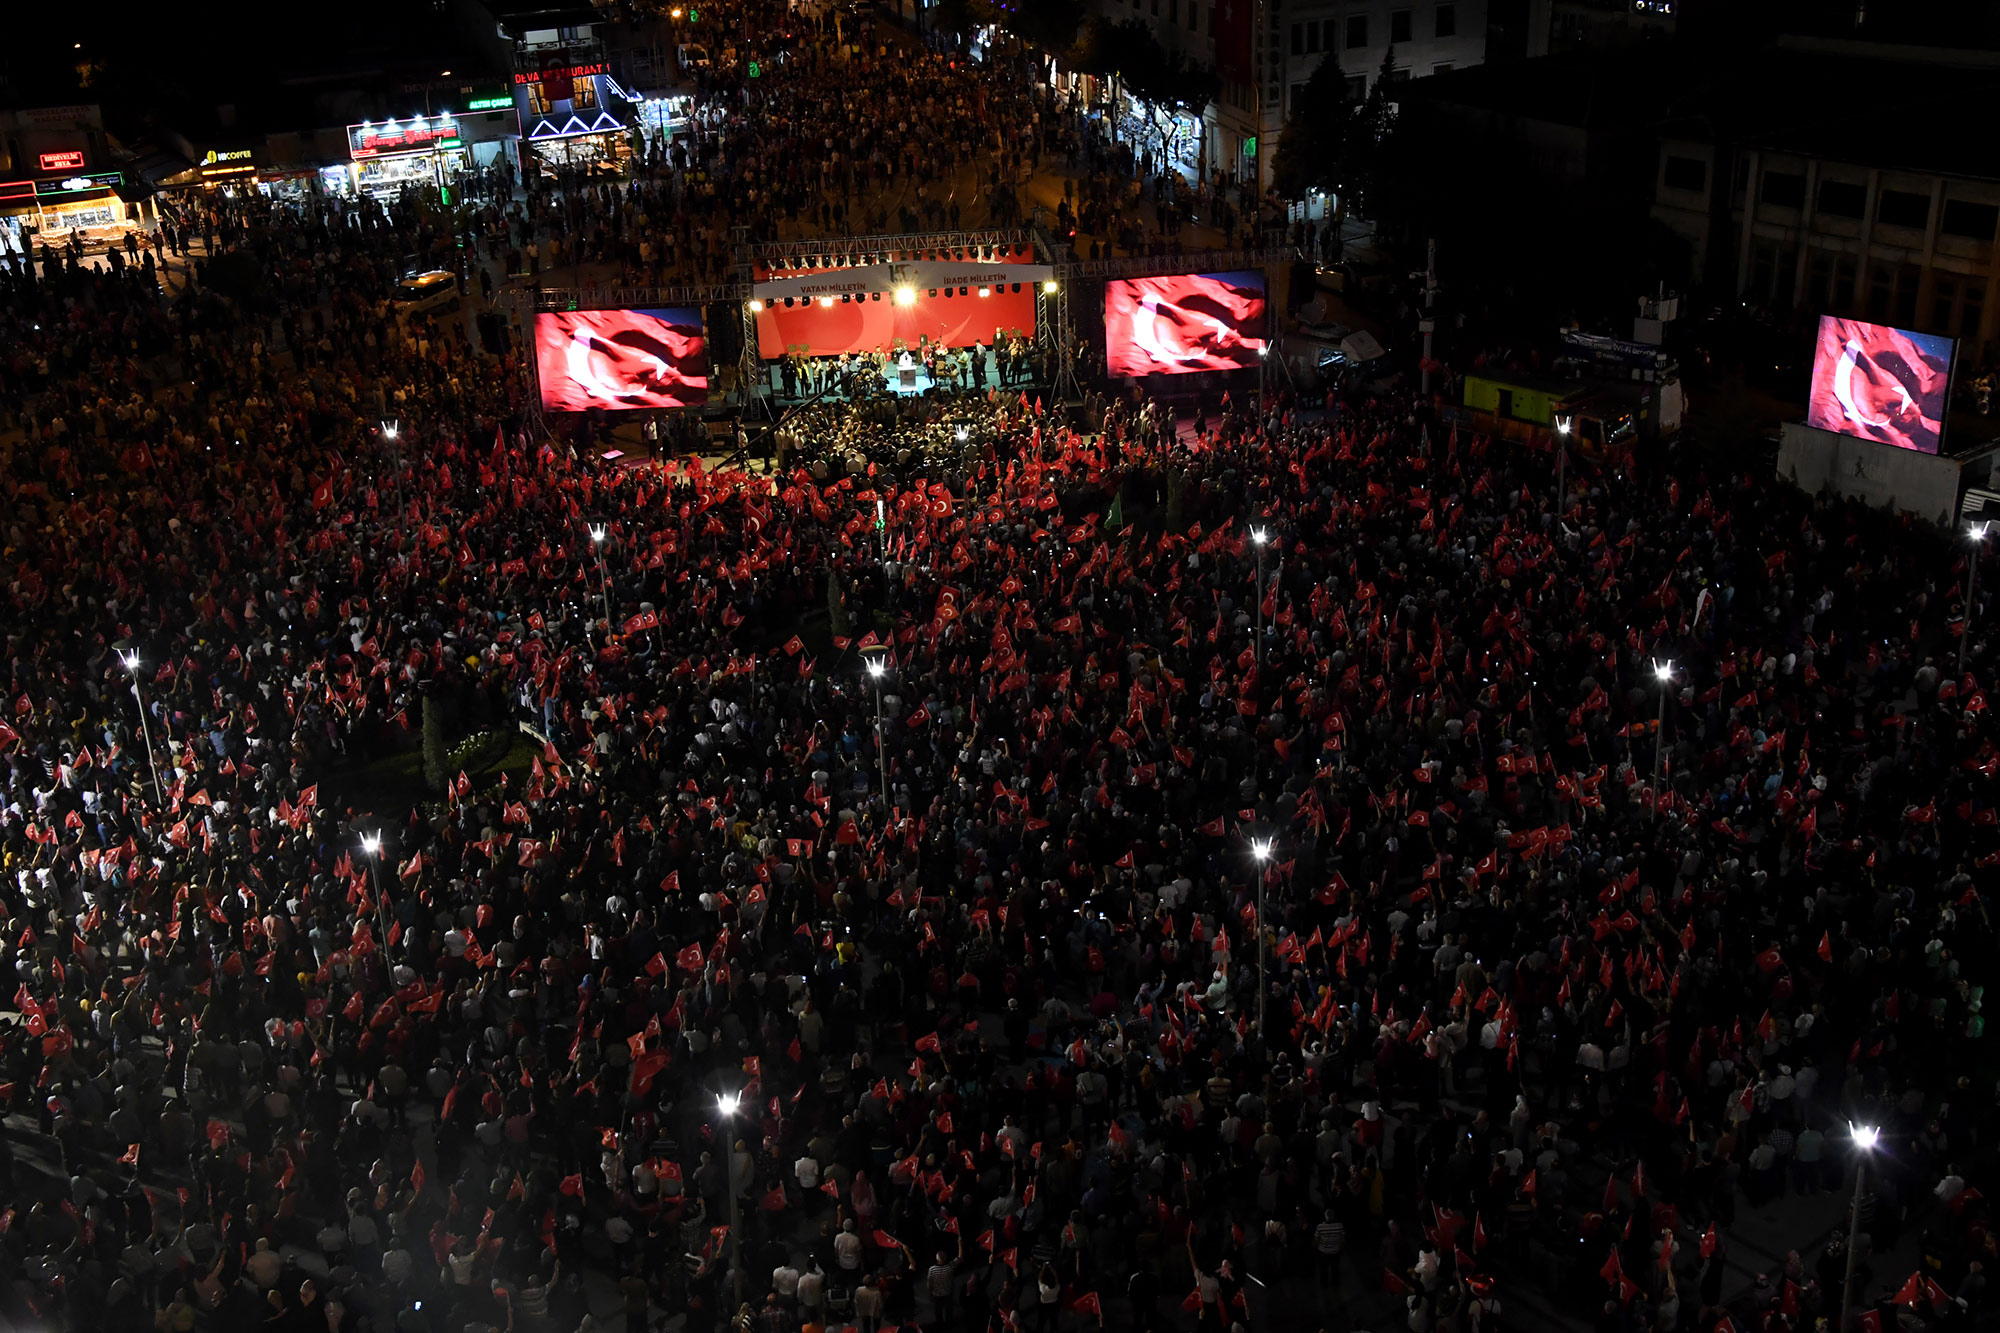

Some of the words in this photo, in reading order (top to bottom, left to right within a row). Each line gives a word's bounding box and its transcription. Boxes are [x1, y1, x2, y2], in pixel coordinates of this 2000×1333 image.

[515, 71, 540, 84] DEVA
[363, 135, 404, 148] Konya
[943, 276, 968, 285] İRADE
[970, 273, 1007, 283] MİLLETİN
[800, 285, 827, 294] VATAN
[829, 283, 866, 292] MİLLETİN
